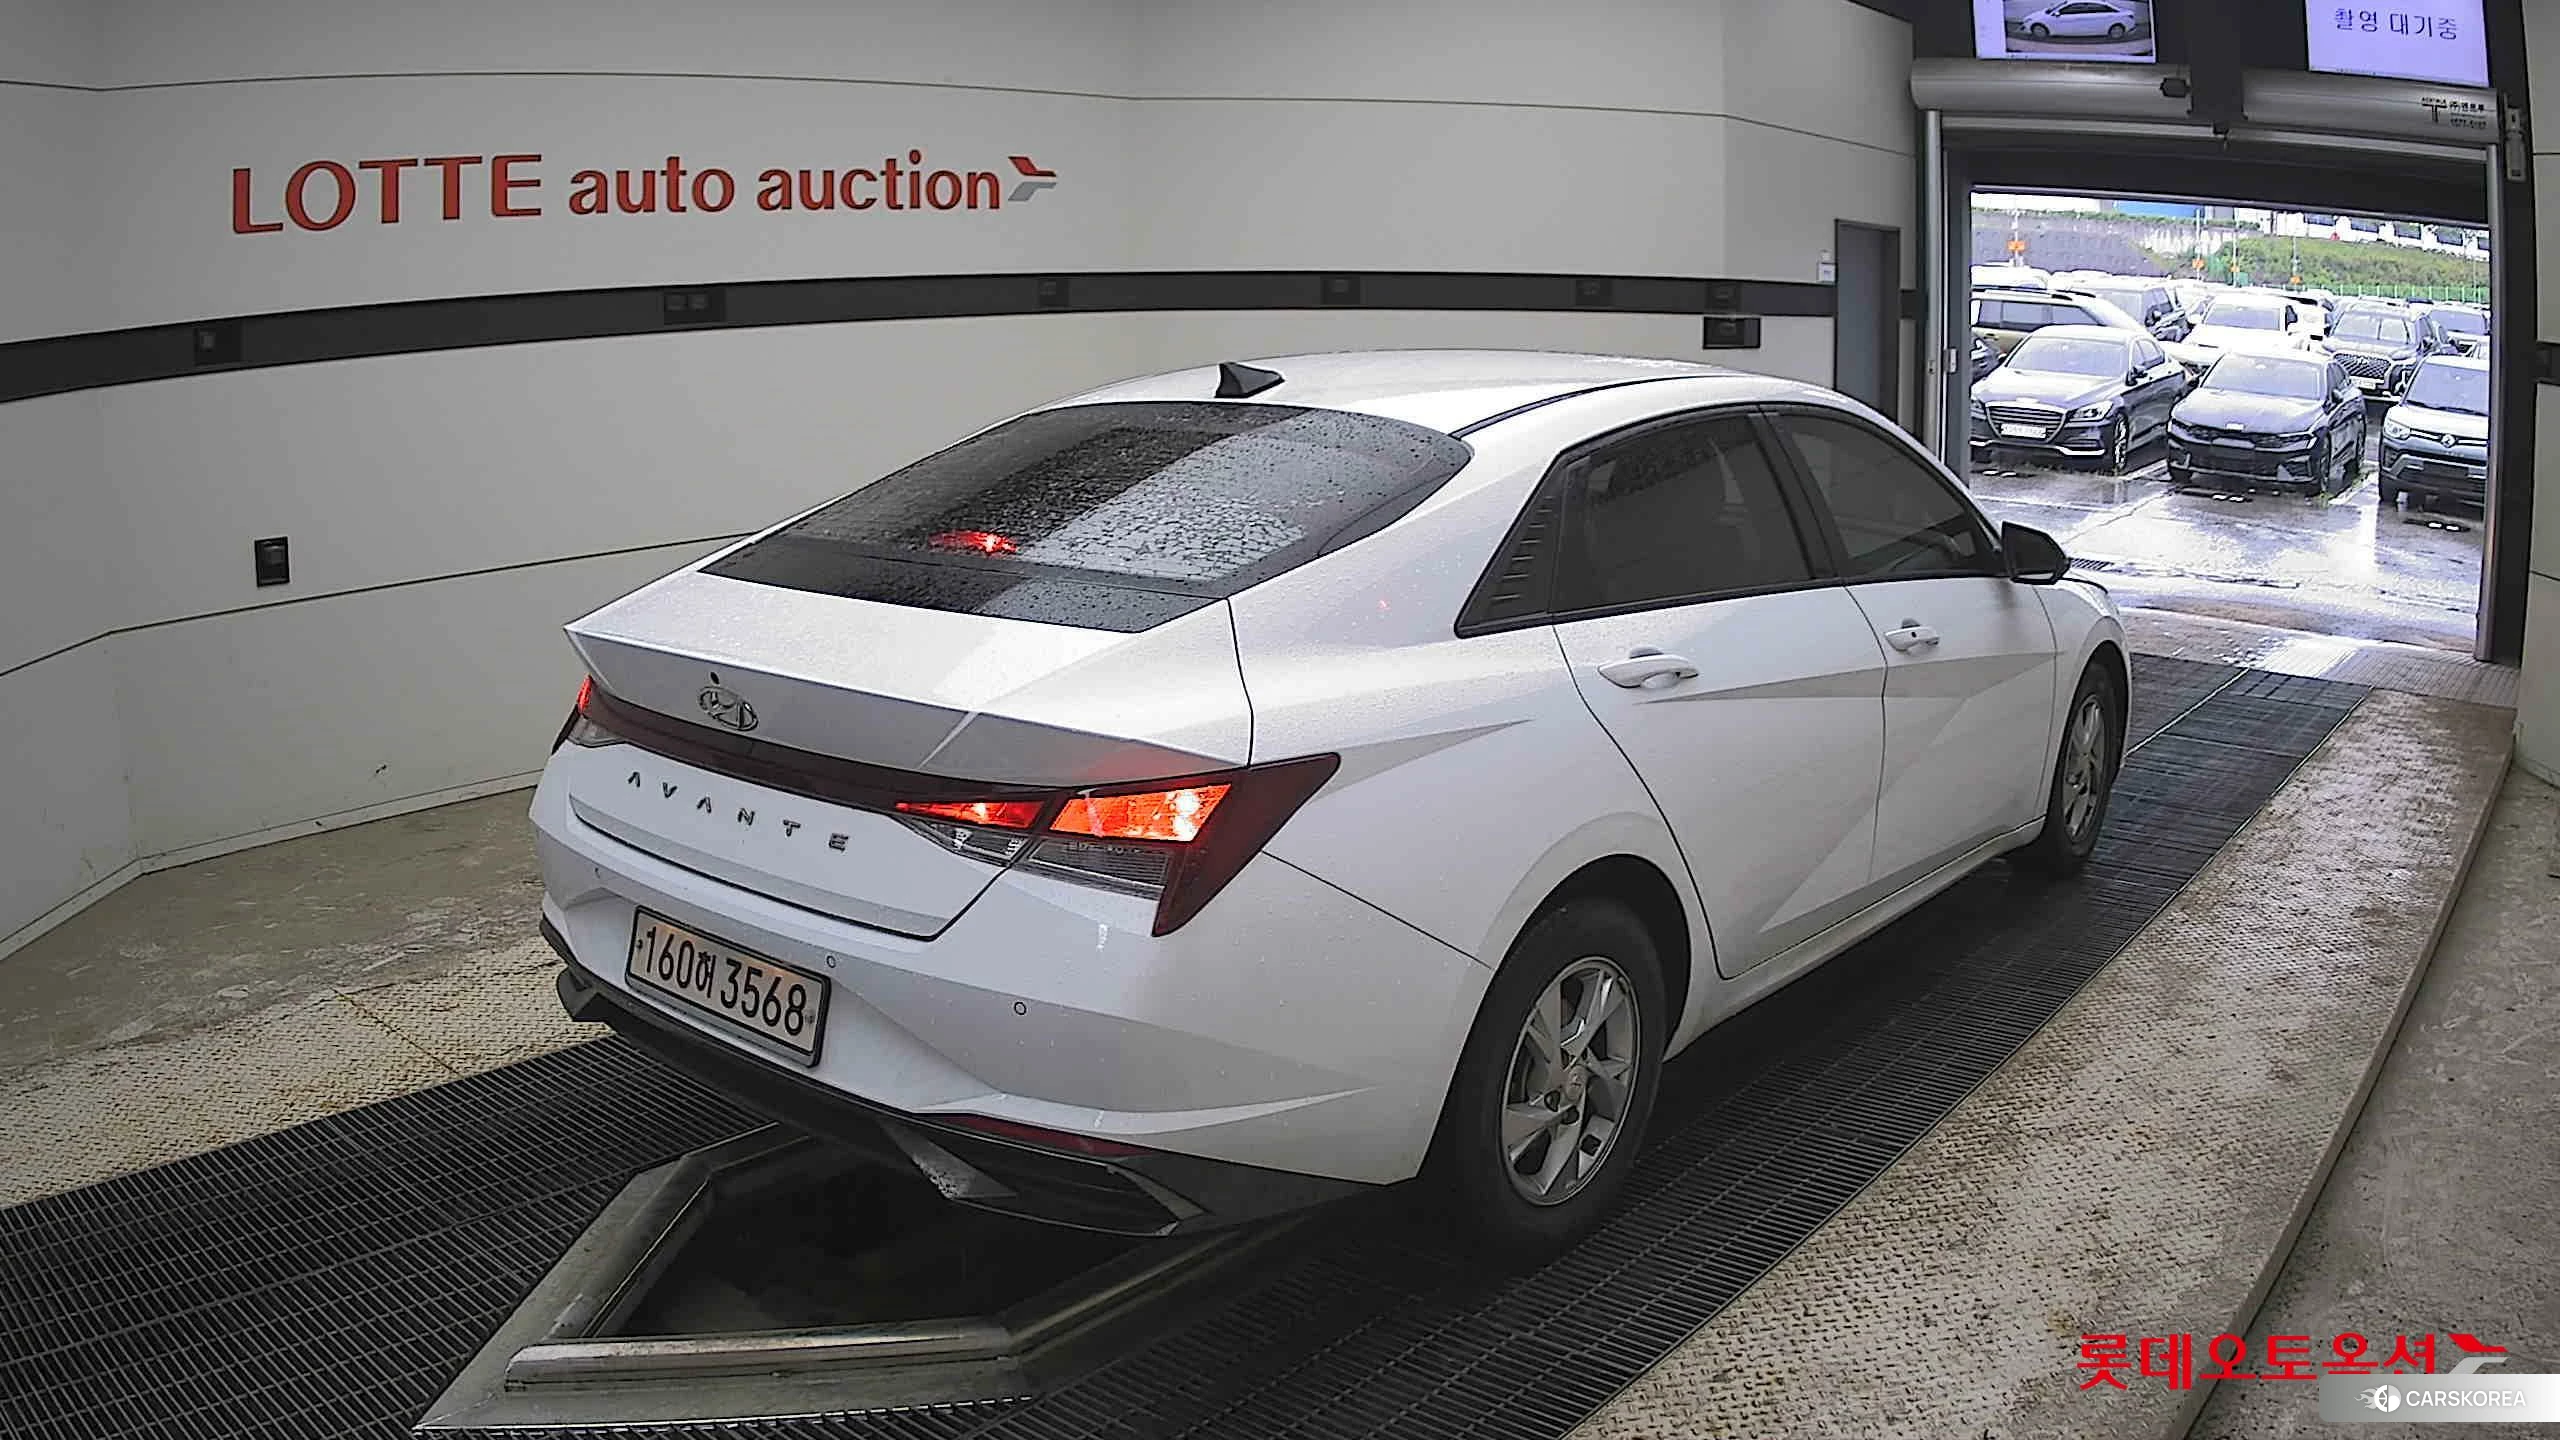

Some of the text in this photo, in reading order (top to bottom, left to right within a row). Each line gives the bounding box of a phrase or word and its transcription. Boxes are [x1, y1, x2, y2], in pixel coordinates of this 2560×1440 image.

[2334, 8, 2458, 40] 촬영 대기중
[232, 149, 1002, 234] LOTTE auto auction
[627, 771, 850, 853] AVANTE
[720, 957, 807, 1036] 3568
